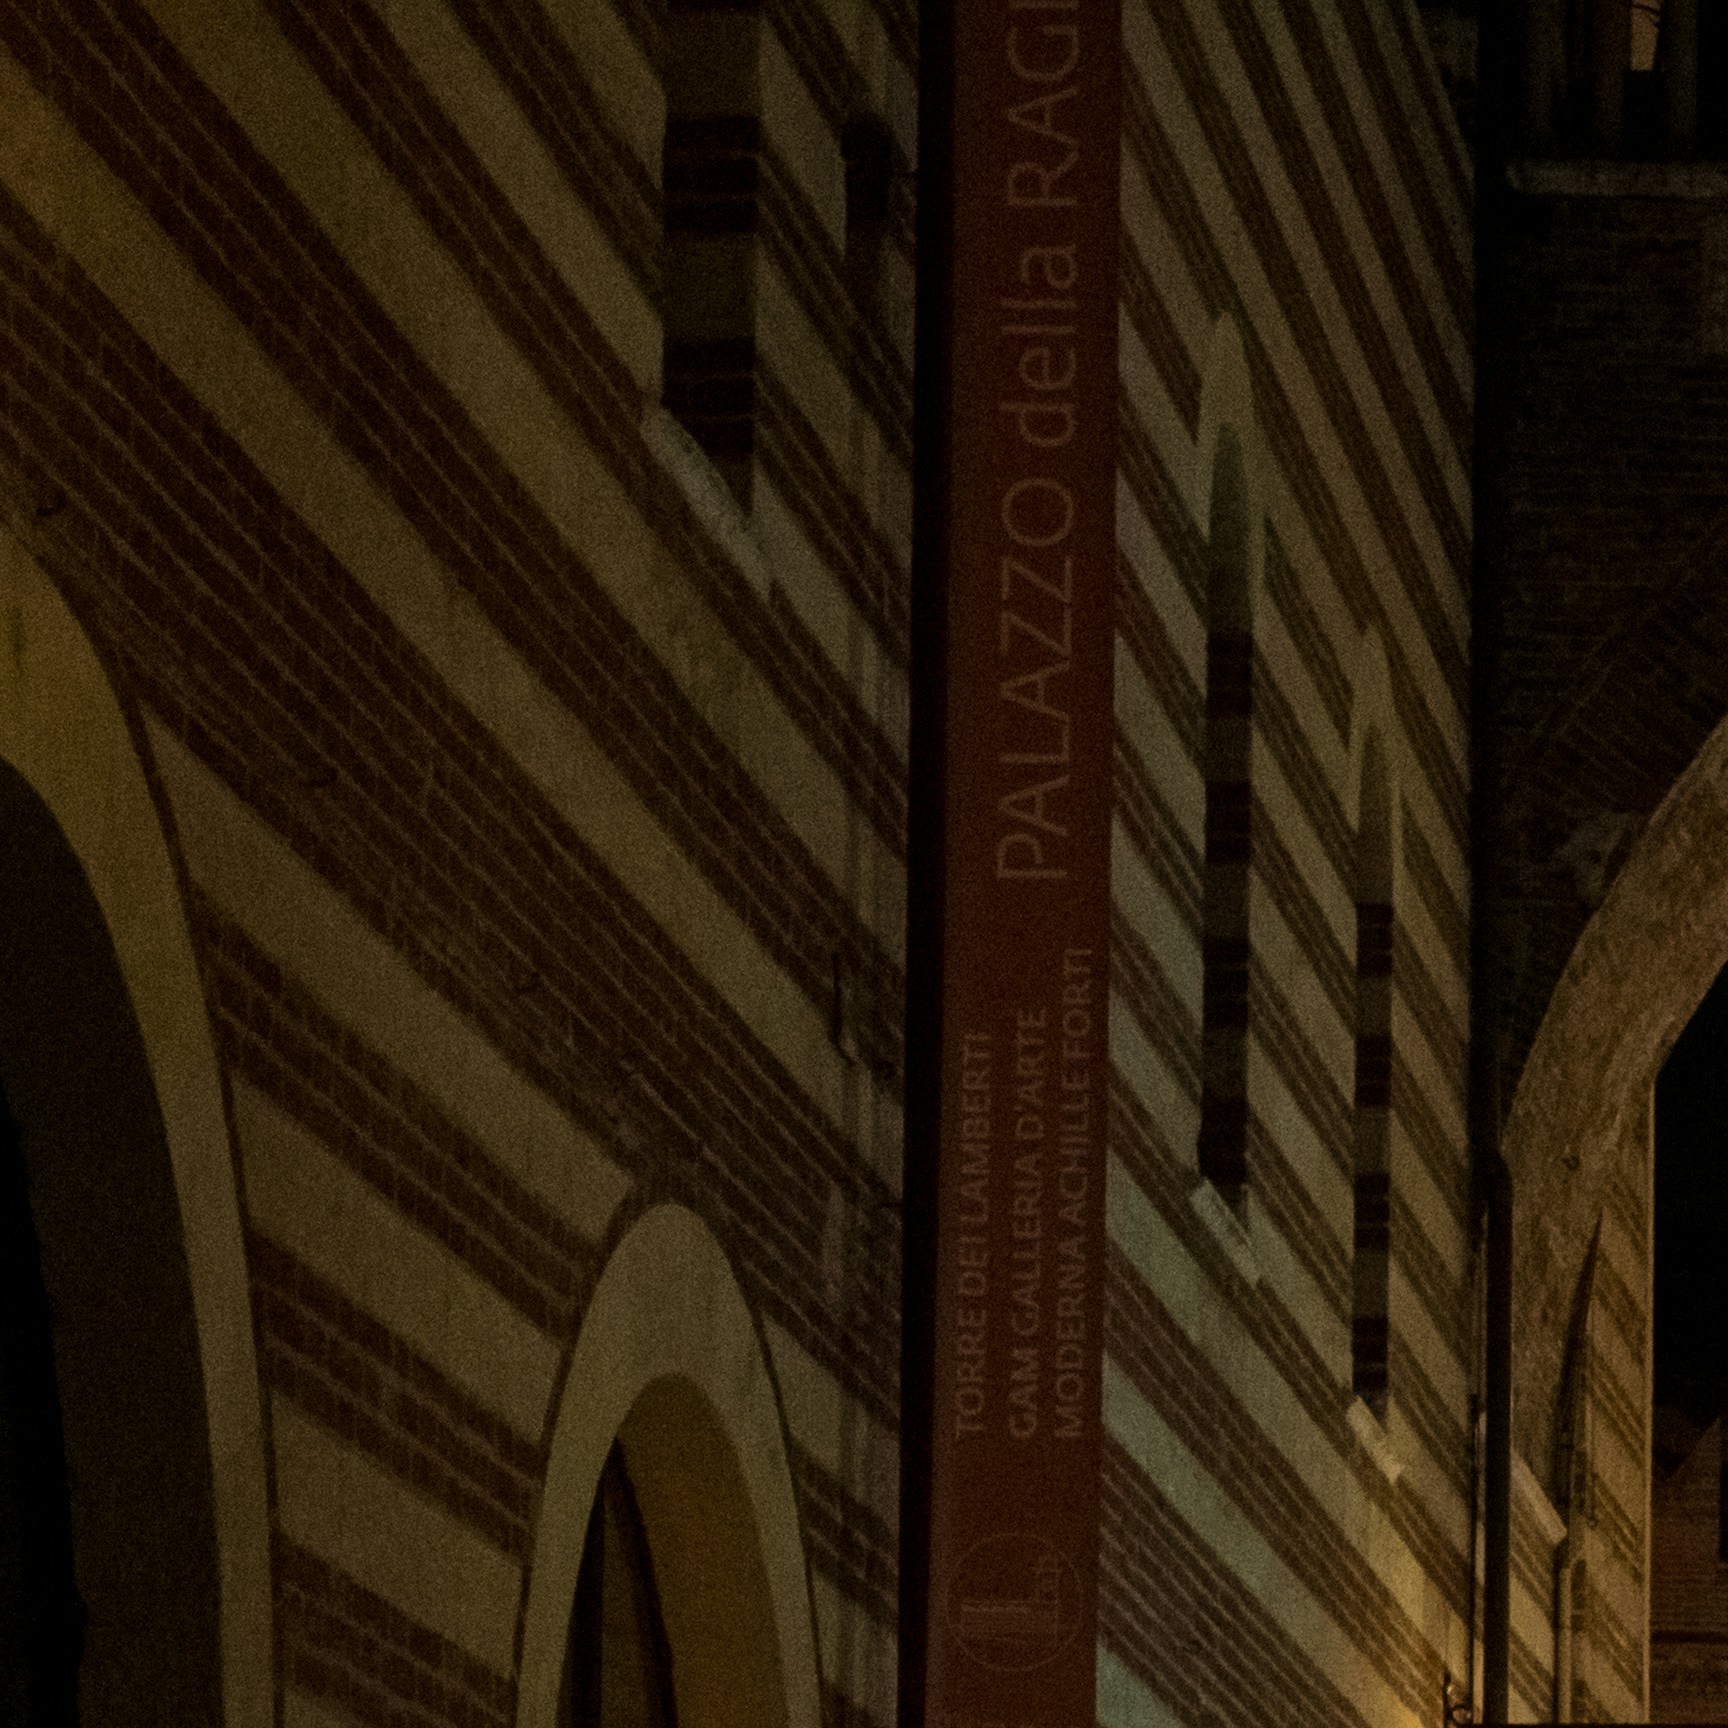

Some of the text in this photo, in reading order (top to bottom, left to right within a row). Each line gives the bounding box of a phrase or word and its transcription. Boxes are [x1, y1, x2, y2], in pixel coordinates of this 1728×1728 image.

[1001, 243, 1077, 448] della
[997, 477, 1074, 882] PALAZZO
[954, 1032, 993, 1440] TORRE DEI LAMBERTI
[1008, 1007, 1047, 1440] GAM GALLERIA D'ARTE
[1054, 947, 1094, 1439] MODERNA ACHILLE FORTI
